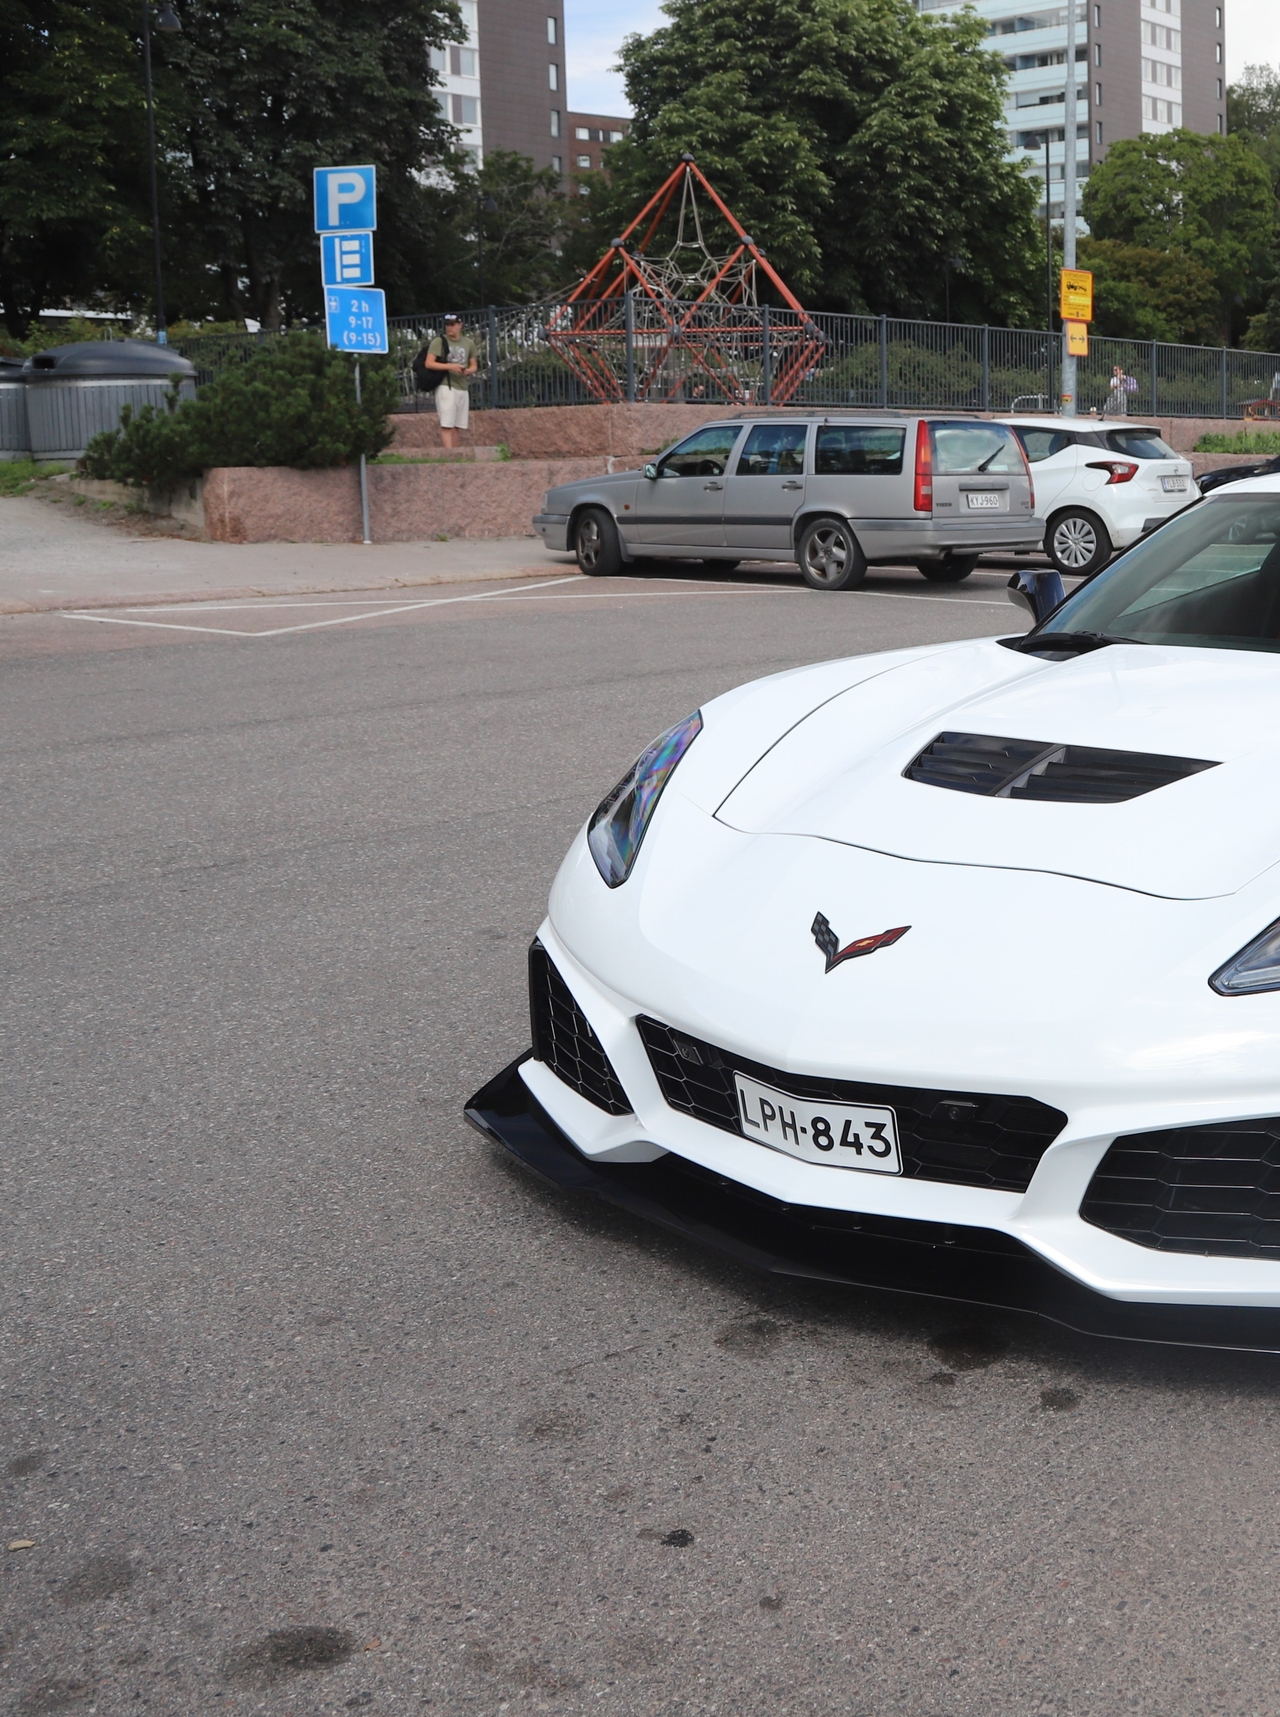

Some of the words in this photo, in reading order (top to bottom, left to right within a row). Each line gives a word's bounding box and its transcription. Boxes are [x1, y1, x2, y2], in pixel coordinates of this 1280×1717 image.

[327, 172, 366, 227] P
[351, 299, 359, 313] 2
[361, 300, 369, 313] h
[348, 315, 373, 329] 9-17
[343, 330, 381, 347] (9-15)
[969, 495, 999, 507] KYJ-960
[739, 1088, 892, 1158] LPH-843
